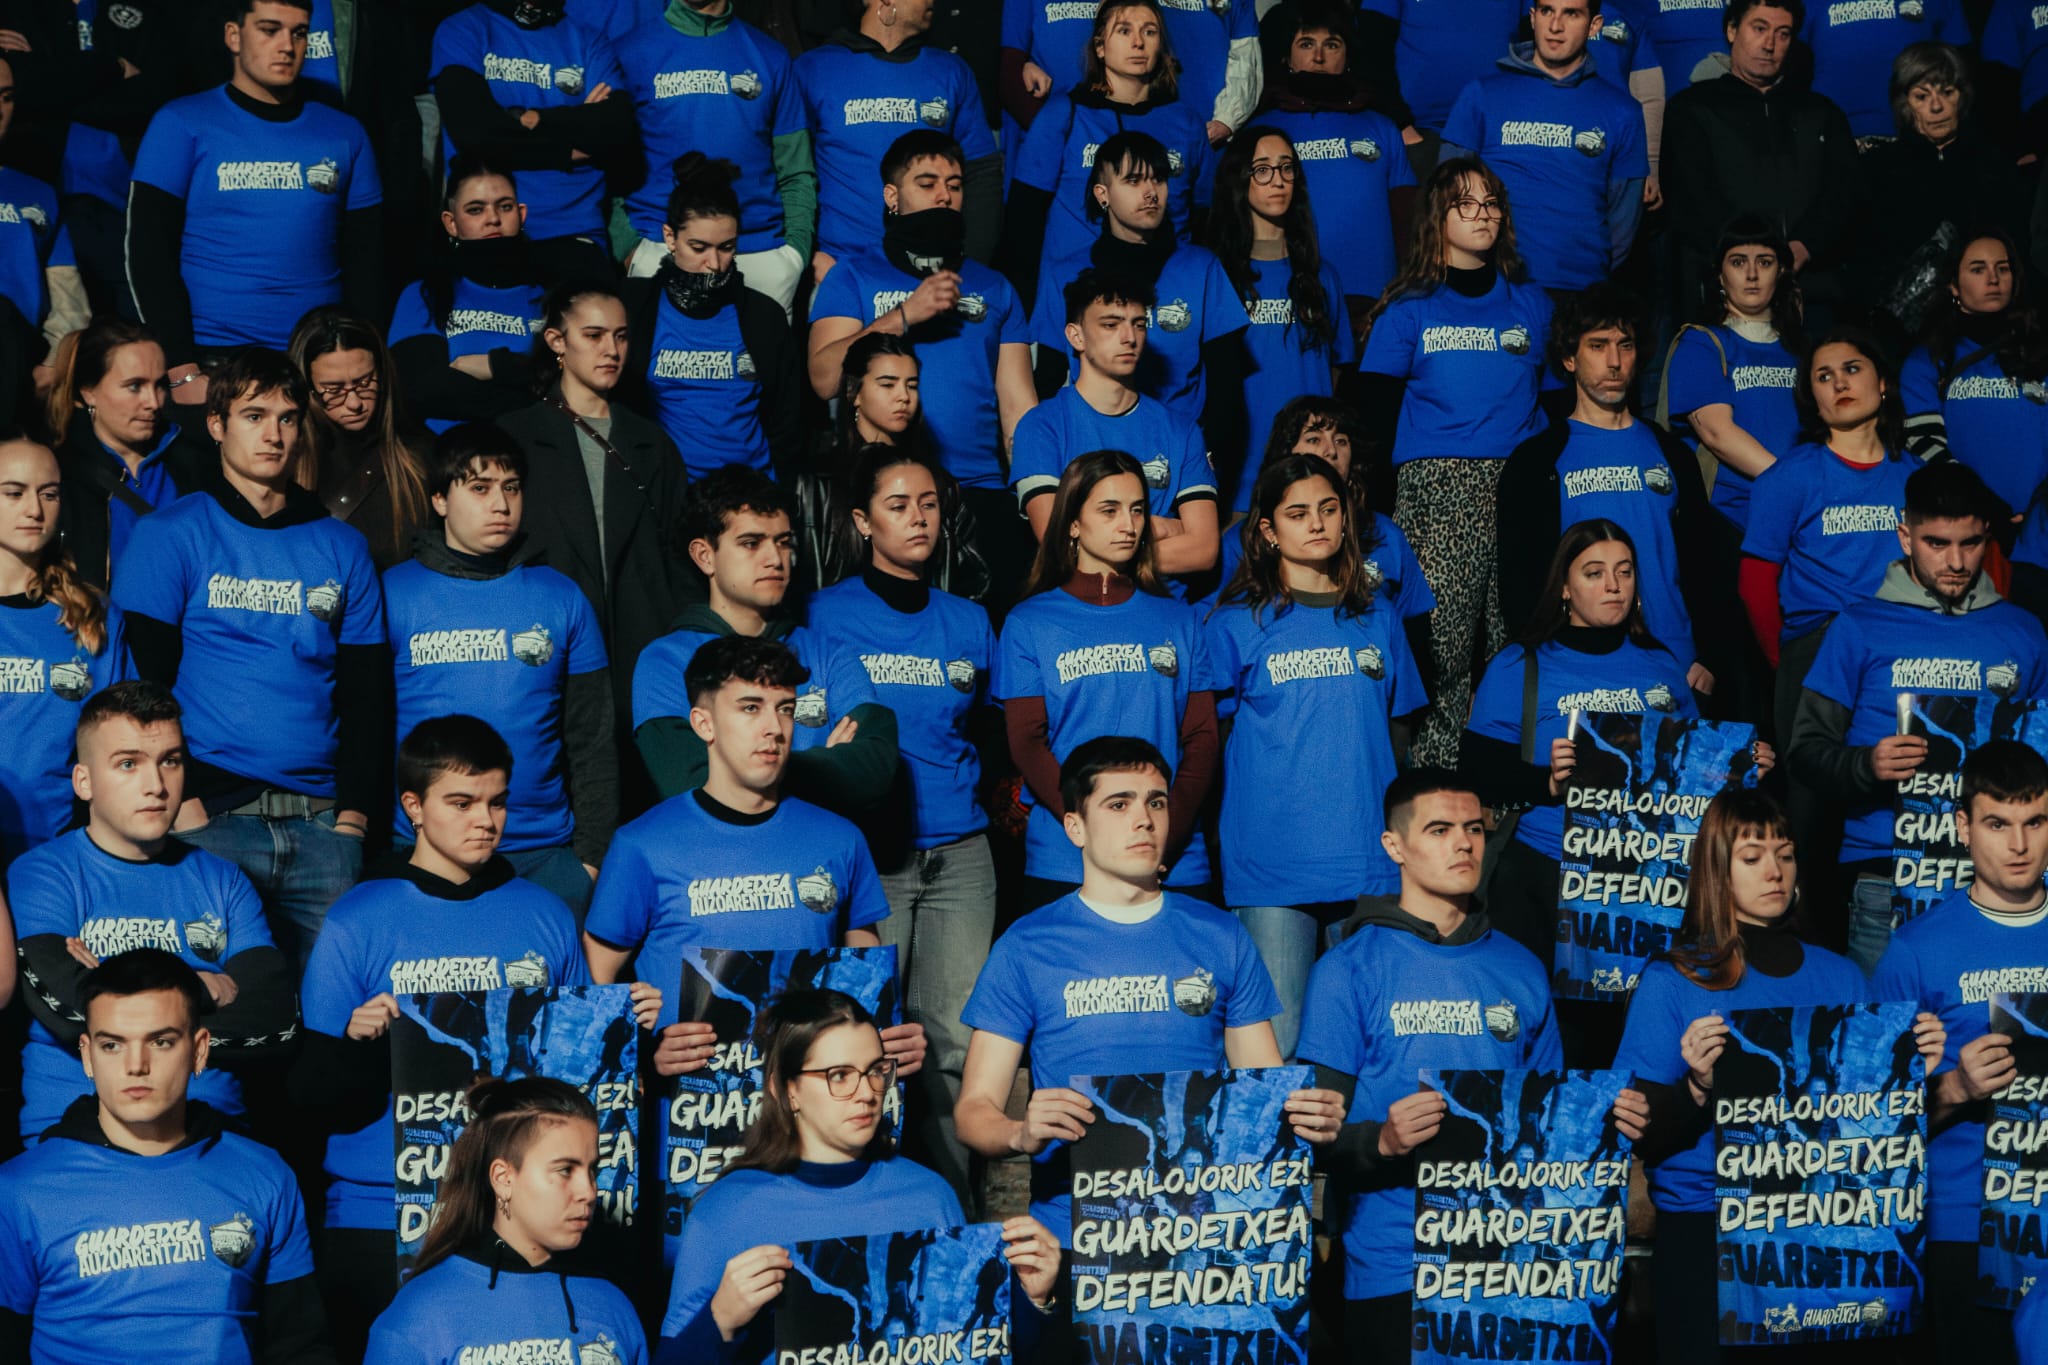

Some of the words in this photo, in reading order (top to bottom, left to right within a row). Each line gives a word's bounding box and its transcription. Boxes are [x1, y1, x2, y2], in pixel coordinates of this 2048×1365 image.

[654, 69, 727, 90] GUARDETXEA
[655, 80, 729, 99] AUZOARENTZAT!
[845, 97, 917, 115] GUARDETXEA
[846, 110, 918, 126] AUZOARENTZAT!
[1501, 120, 1574, 140] GUARDETXEA
[1501, 133, 1572, 149] AUZOARENTZAT!
[217, 160, 301, 179] GUARDETXEA
[217, 174, 304, 192] AUZOARENTZAT!
[1422, 325, 1496, 343] GUARDETXEA
[1424, 338, 1498, 354] AUZOARENTZAT!
[653, 362, 734, 380] AUZOARENTZAT!
[1563, 465, 1639, 487] GUARDETXEA
[1567, 476, 1643, 499] AUZOARENTZAT!
[1821, 504, 1897, 523] GUARDETXEA
[207, 572, 302, 600] GUARDETXEA
[207, 589, 302, 616] AUZOARENTZAT!
[409, 628, 507, 652] GUARDETXEA
[411, 644, 509, 667] AUZOARENTZAT!
[1056, 643, 1144, 670] GUARDETXEA
[1266, 646, 1350, 670] GUARDETXEA
[1891, 657, 1981, 677] GUARDETXEA
[1059, 657, 1148, 685] AUZOARENTZAT!
[1270, 660, 1355, 686] AUZOARENTZAT!
[1891, 670, 1982, 691] AUZOARENTZAT!
[1557, 687, 1639, 711] GUARDETXEA
[1562, 826, 1699, 867] GUARDET
[687, 873, 793, 900] GUARDETXEA
[1561, 869, 1690, 909] DEFEND
[690, 891, 796, 918] AUZOARENTZAT!
[389, 956, 499, 981] GUARDETXEA
[1063, 975, 1168, 1001] GUARDETXEA
[1065, 991, 1170, 1019] AUZOARENTZAT!
[1390, 999, 1482, 1022] GUARDETXEA
[1393, 1016, 1485, 1037] AUZOARENTZAT!
[596, 1078, 635, 1111] EZ!
[1715, 1090, 1882, 1126] DESALOJORIK
[1887, 1087, 1925, 1117] EZ!
[1716, 1133, 1926, 1181] GUARDETXEA
[1072, 1161, 1265, 1200] DESALOJORIK
[1269, 1156, 1311, 1189] EZ!
[1416, 1158, 1589, 1192] DESALOJORIK
[1593, 1158, 1629, 1188] EZ!
[1719, 1182, 1925, 1234] DEFENDATU!
[75, 1219, 202, 1257] GUARDETXEA
[1072, 1203, 1311, 1258] GUARDETXEA
[1414, 1205, 1626, 1249] GUARDETXEA
[79, 1239, 206, 1279] AUZOARENTZAT!
[1074, 1255, 1307, 1315] DEFENDATU!
[1415, 1255, 1621, 1303] DEFENDATU!
[1803, 1302, 1861, 1328] GUARDETXEA
[969, 1322, 1010, 1359] EZ!
